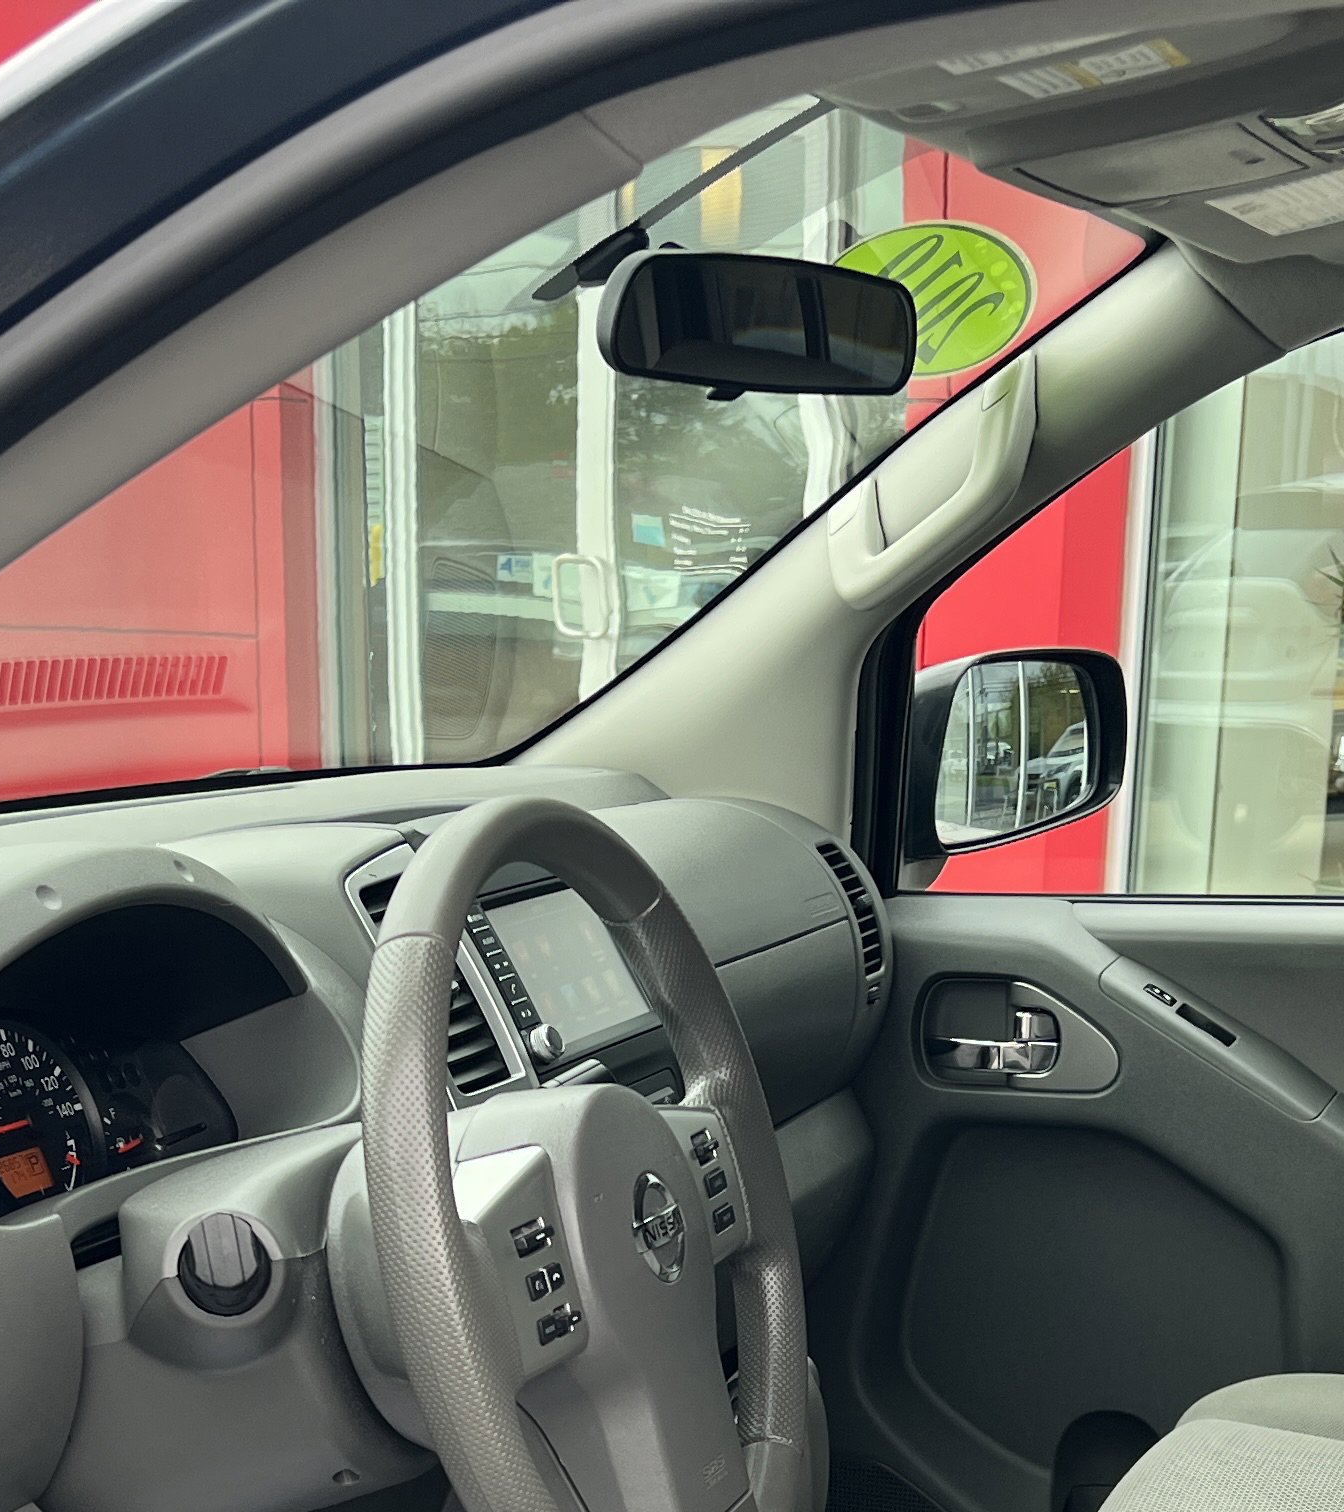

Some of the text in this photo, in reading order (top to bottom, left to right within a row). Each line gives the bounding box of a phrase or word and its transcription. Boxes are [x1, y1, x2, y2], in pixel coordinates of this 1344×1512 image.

[0, 1043, 16, 1058] 80
[21, 1054, 40, 1071] 100
[41, 1076, 59, 1092] 120
[56, 1102, 75, 1118] 140
[109, 1107, 116, 1119] F
